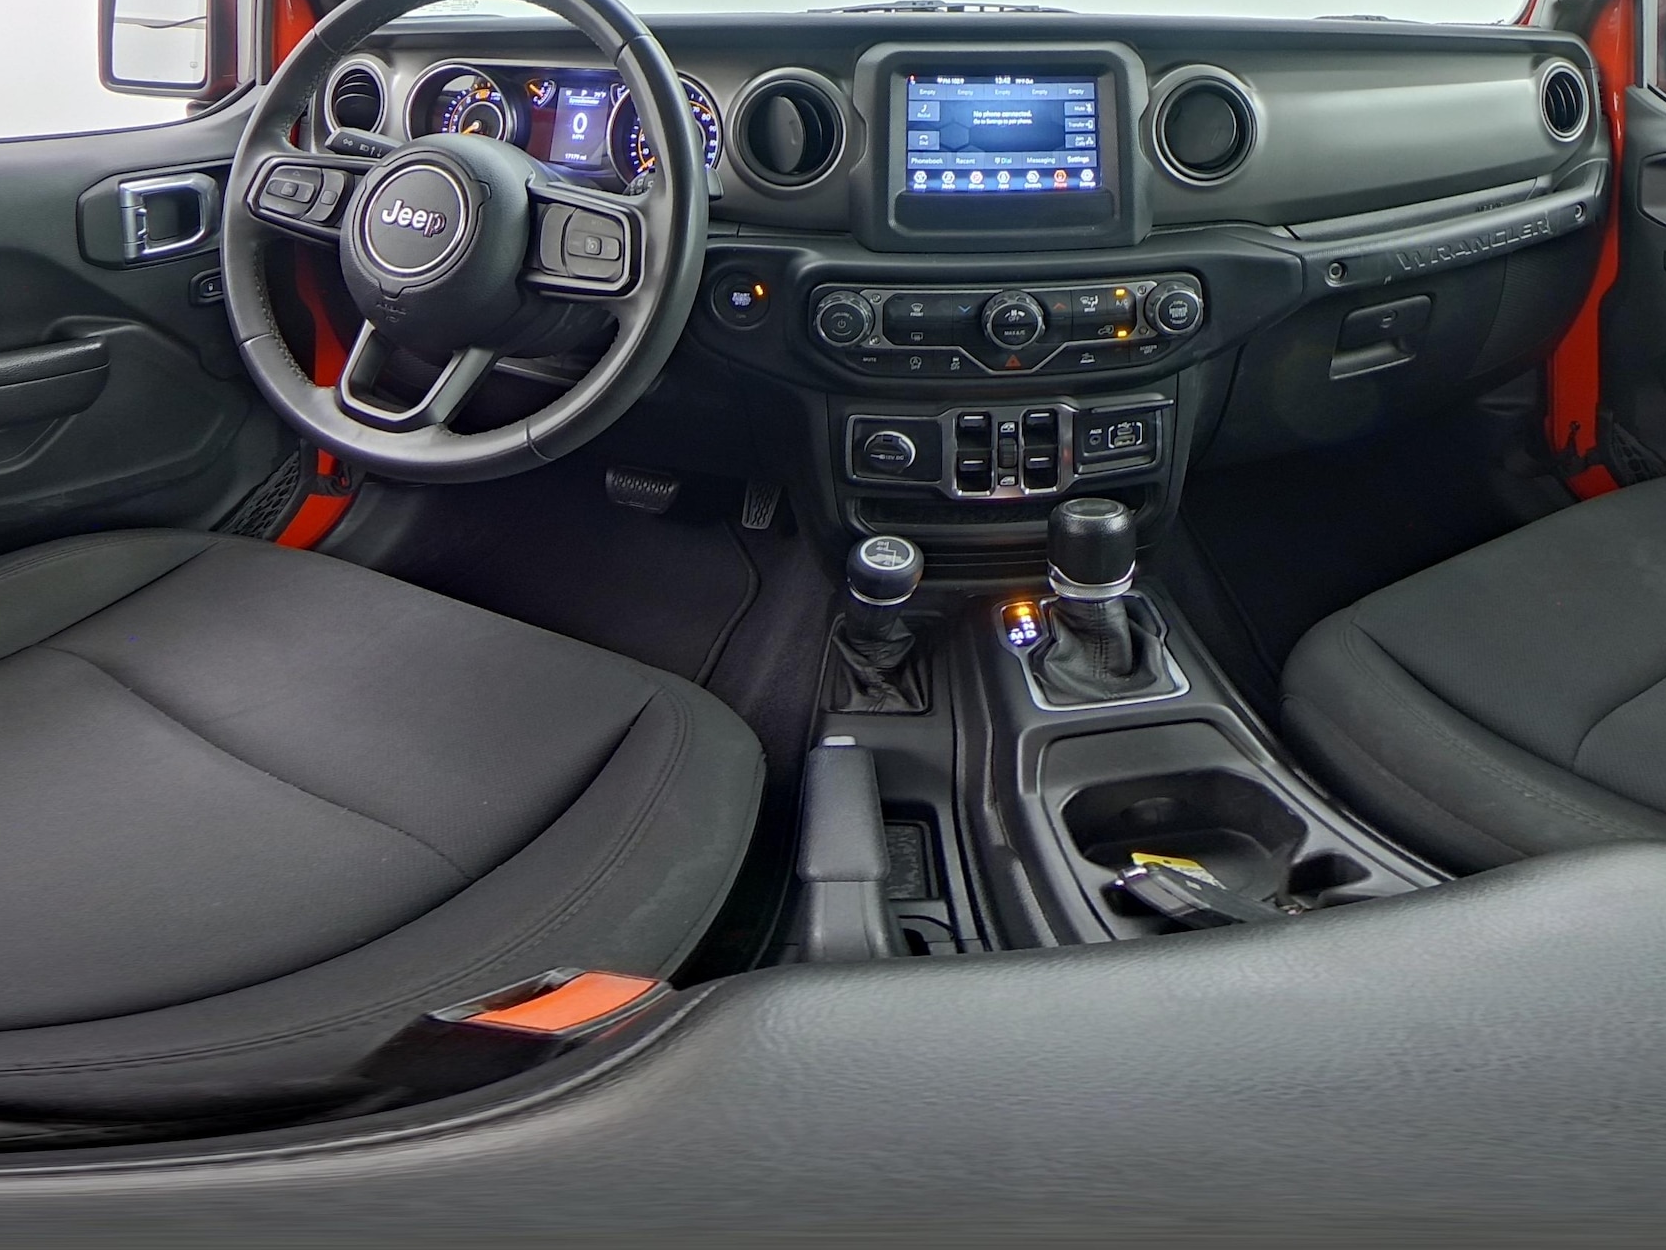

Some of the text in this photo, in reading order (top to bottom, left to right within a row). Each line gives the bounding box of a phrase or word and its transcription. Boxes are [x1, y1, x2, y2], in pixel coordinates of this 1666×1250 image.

[919, 89, 936, 97] Empty
[957, 89, 974, 97] Empty
[995, 89, 1011, 97] Empty
[1032, 88, 1048, 96] Empty
[1068, 88, 1085, 96] Empty
[983, 110, 1001, 118] phone
[573, 112, 588, 134] 0
[1026, 156, 1056, 165] Messaging
[1066, 155, 1090, 164] Settings
[381, 199, 446, 238] Jeep
[1396, 220, 1551, 271] WRANGLER
[1010, 631, 1025, 641] M
[1024, 630, 1037, 639] D
